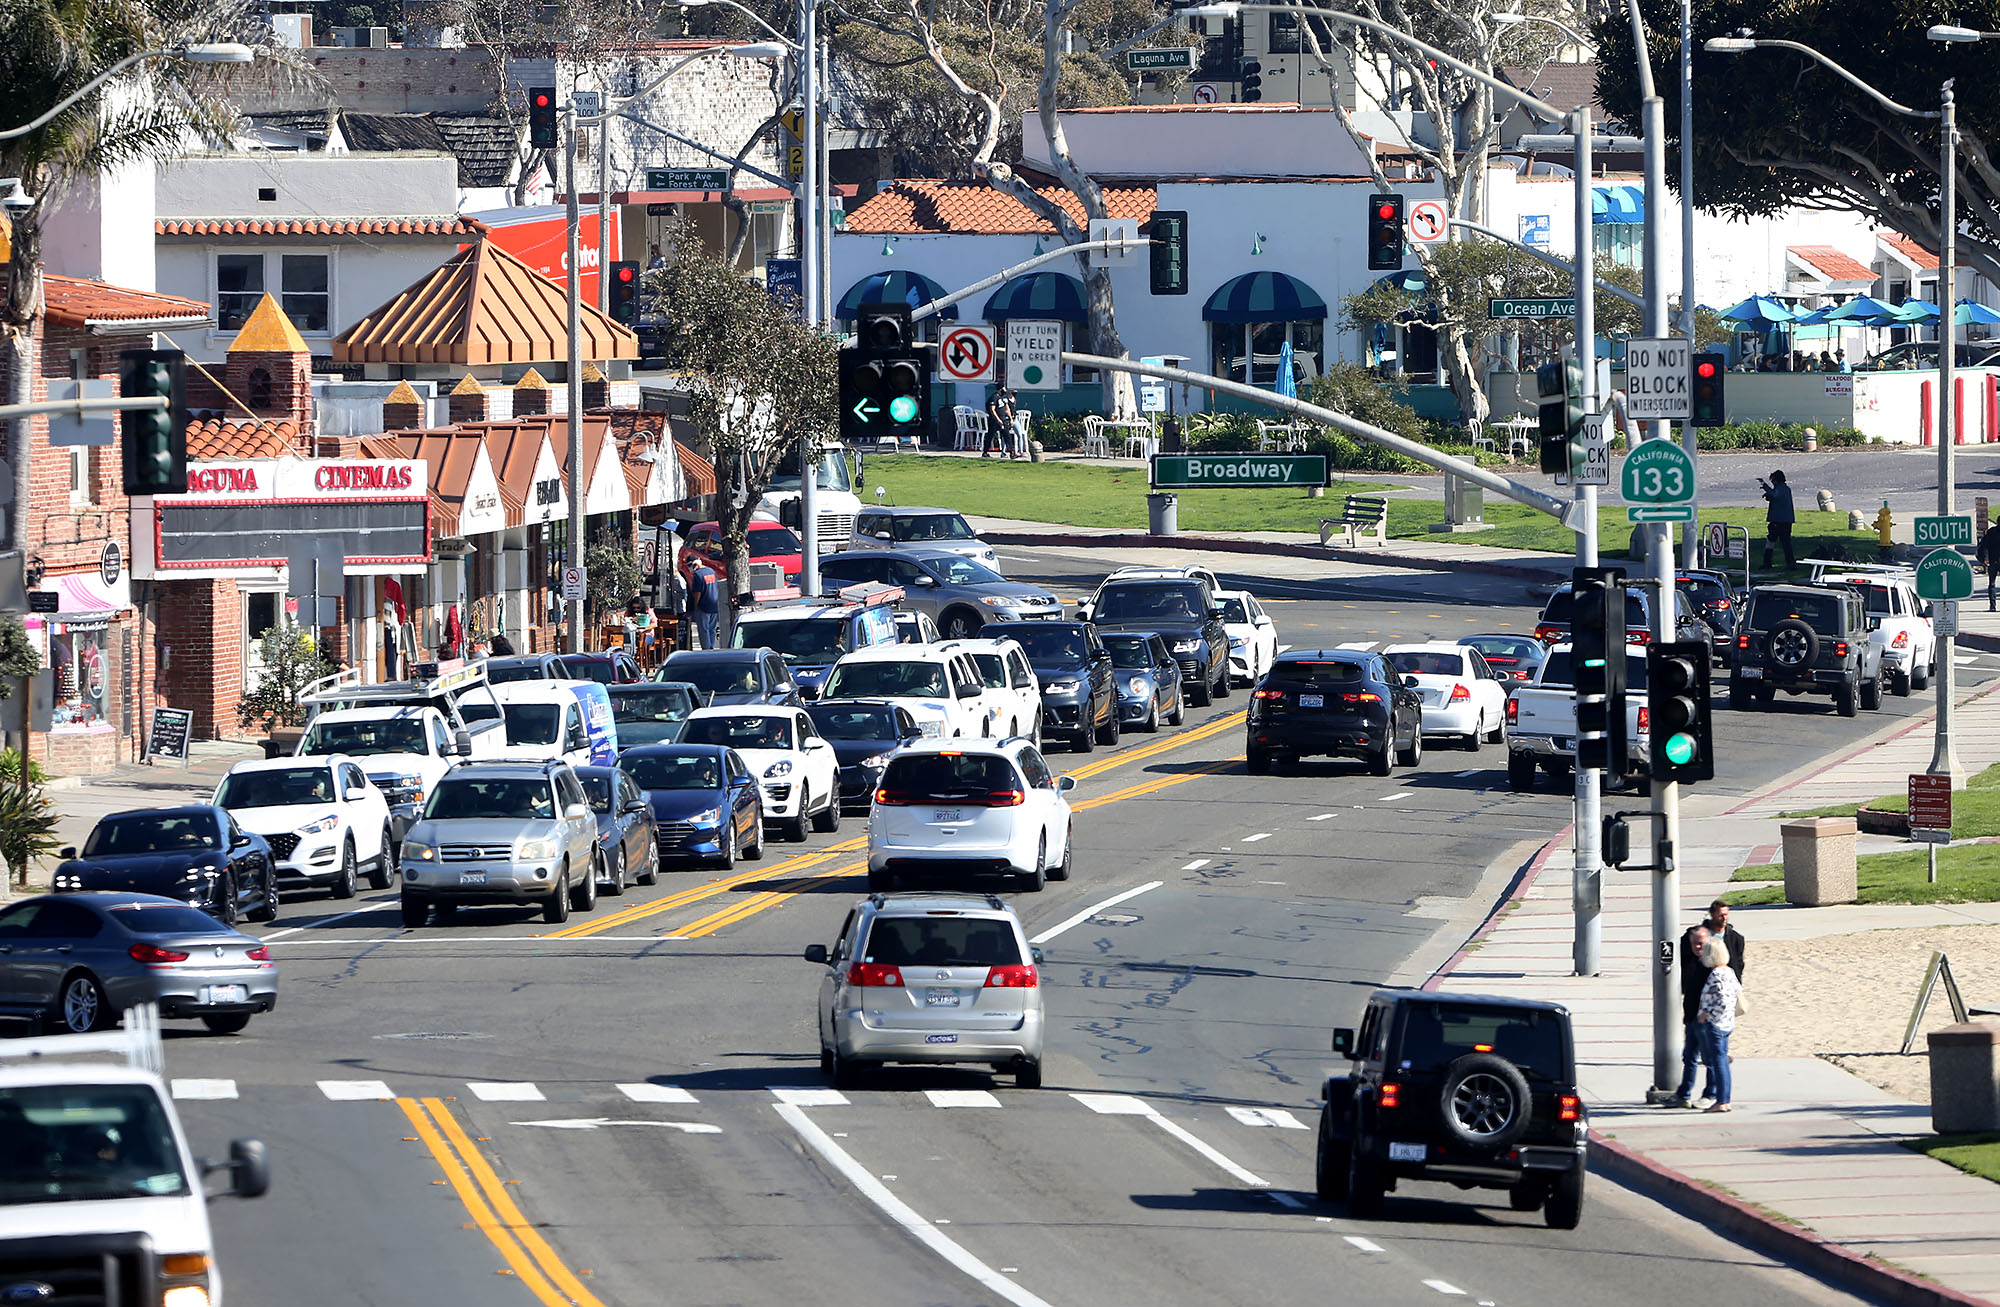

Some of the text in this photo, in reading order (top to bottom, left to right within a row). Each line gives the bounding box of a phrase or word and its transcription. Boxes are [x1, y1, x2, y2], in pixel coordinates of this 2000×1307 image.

[1134, 52, 1185, 66] Laguna Ave
[584, 96, 597, 105] NOT
[668, 172, 712, 181] Park Ave
[1503, 302, 1576, 315] Ocean Ave
[1011, 326, 1057, 334] LEFT TURN
[1015, 338, 1054, 349] YIELD
[1011, 352, 1056, 361] ON GREEN
[1631, 349, 1685, 368] DO NOT
[1630, 376, 1687, 394] BLOCK
[1630, 398, 1688, 411] INTERSECTION
[1631, 451, 1684, 465] CALIFORNIA
[1187, 459, 1293, 482] Broadway
[187, 465, 412, 491] AGUNA CINEMAS
[1631, 467, 1684, 496] 133
[1918, 522, 1968, 540] SOUTH
[436, 541, 465, 551] Trade
[1923, 558, 1964, 570] CALIFORNIA
[1940, 570, 1947, 594] 1
